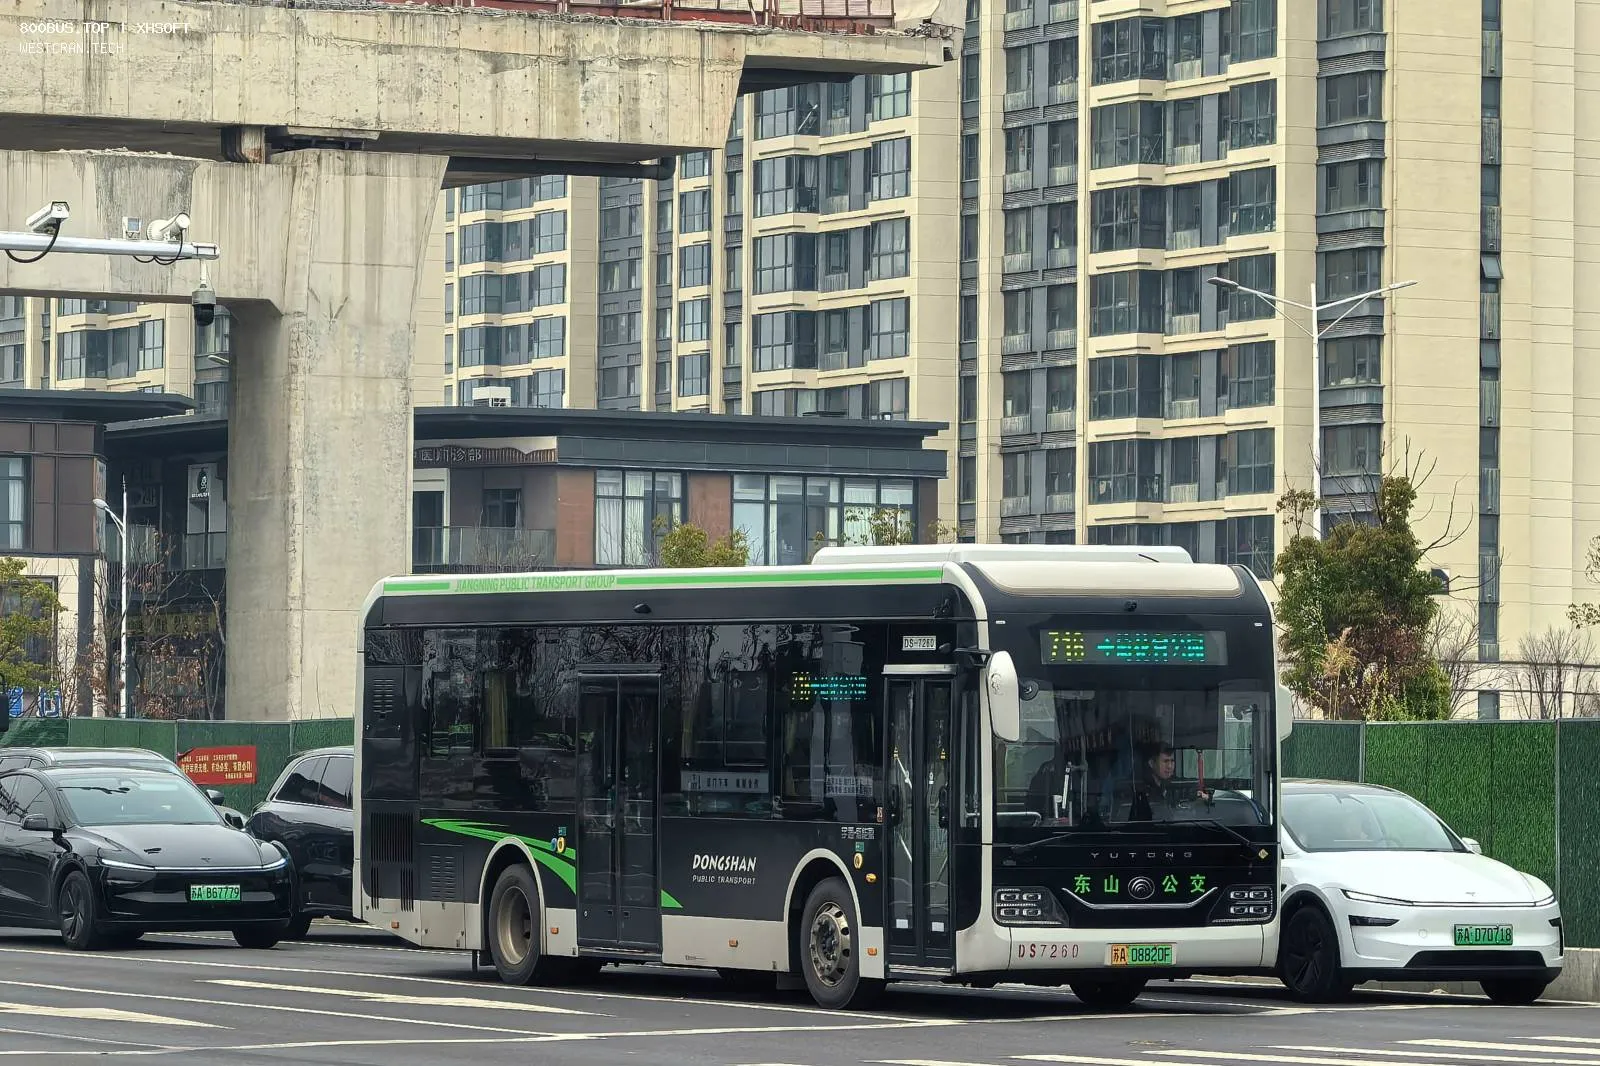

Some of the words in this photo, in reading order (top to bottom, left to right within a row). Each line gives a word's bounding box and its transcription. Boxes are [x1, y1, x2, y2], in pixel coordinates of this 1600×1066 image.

[454, 577, 499, 593] JIANGNING
[500, 576, 529, 591] PUBLIC
[531, 575, 583, 590] TRANSPORT
[585, 575, 615, 588] GROUP
[692, 854, 757, 873] DONGSHAN
[692, 874, 715, 883] PUBLIC
[717, 875, 756, 885] TRANSPORT
[1074, 874, 1120, 893] 东山
[1162, 874, 1206, 893] 公交
[1018, 943, 1079, 958] DS7260
